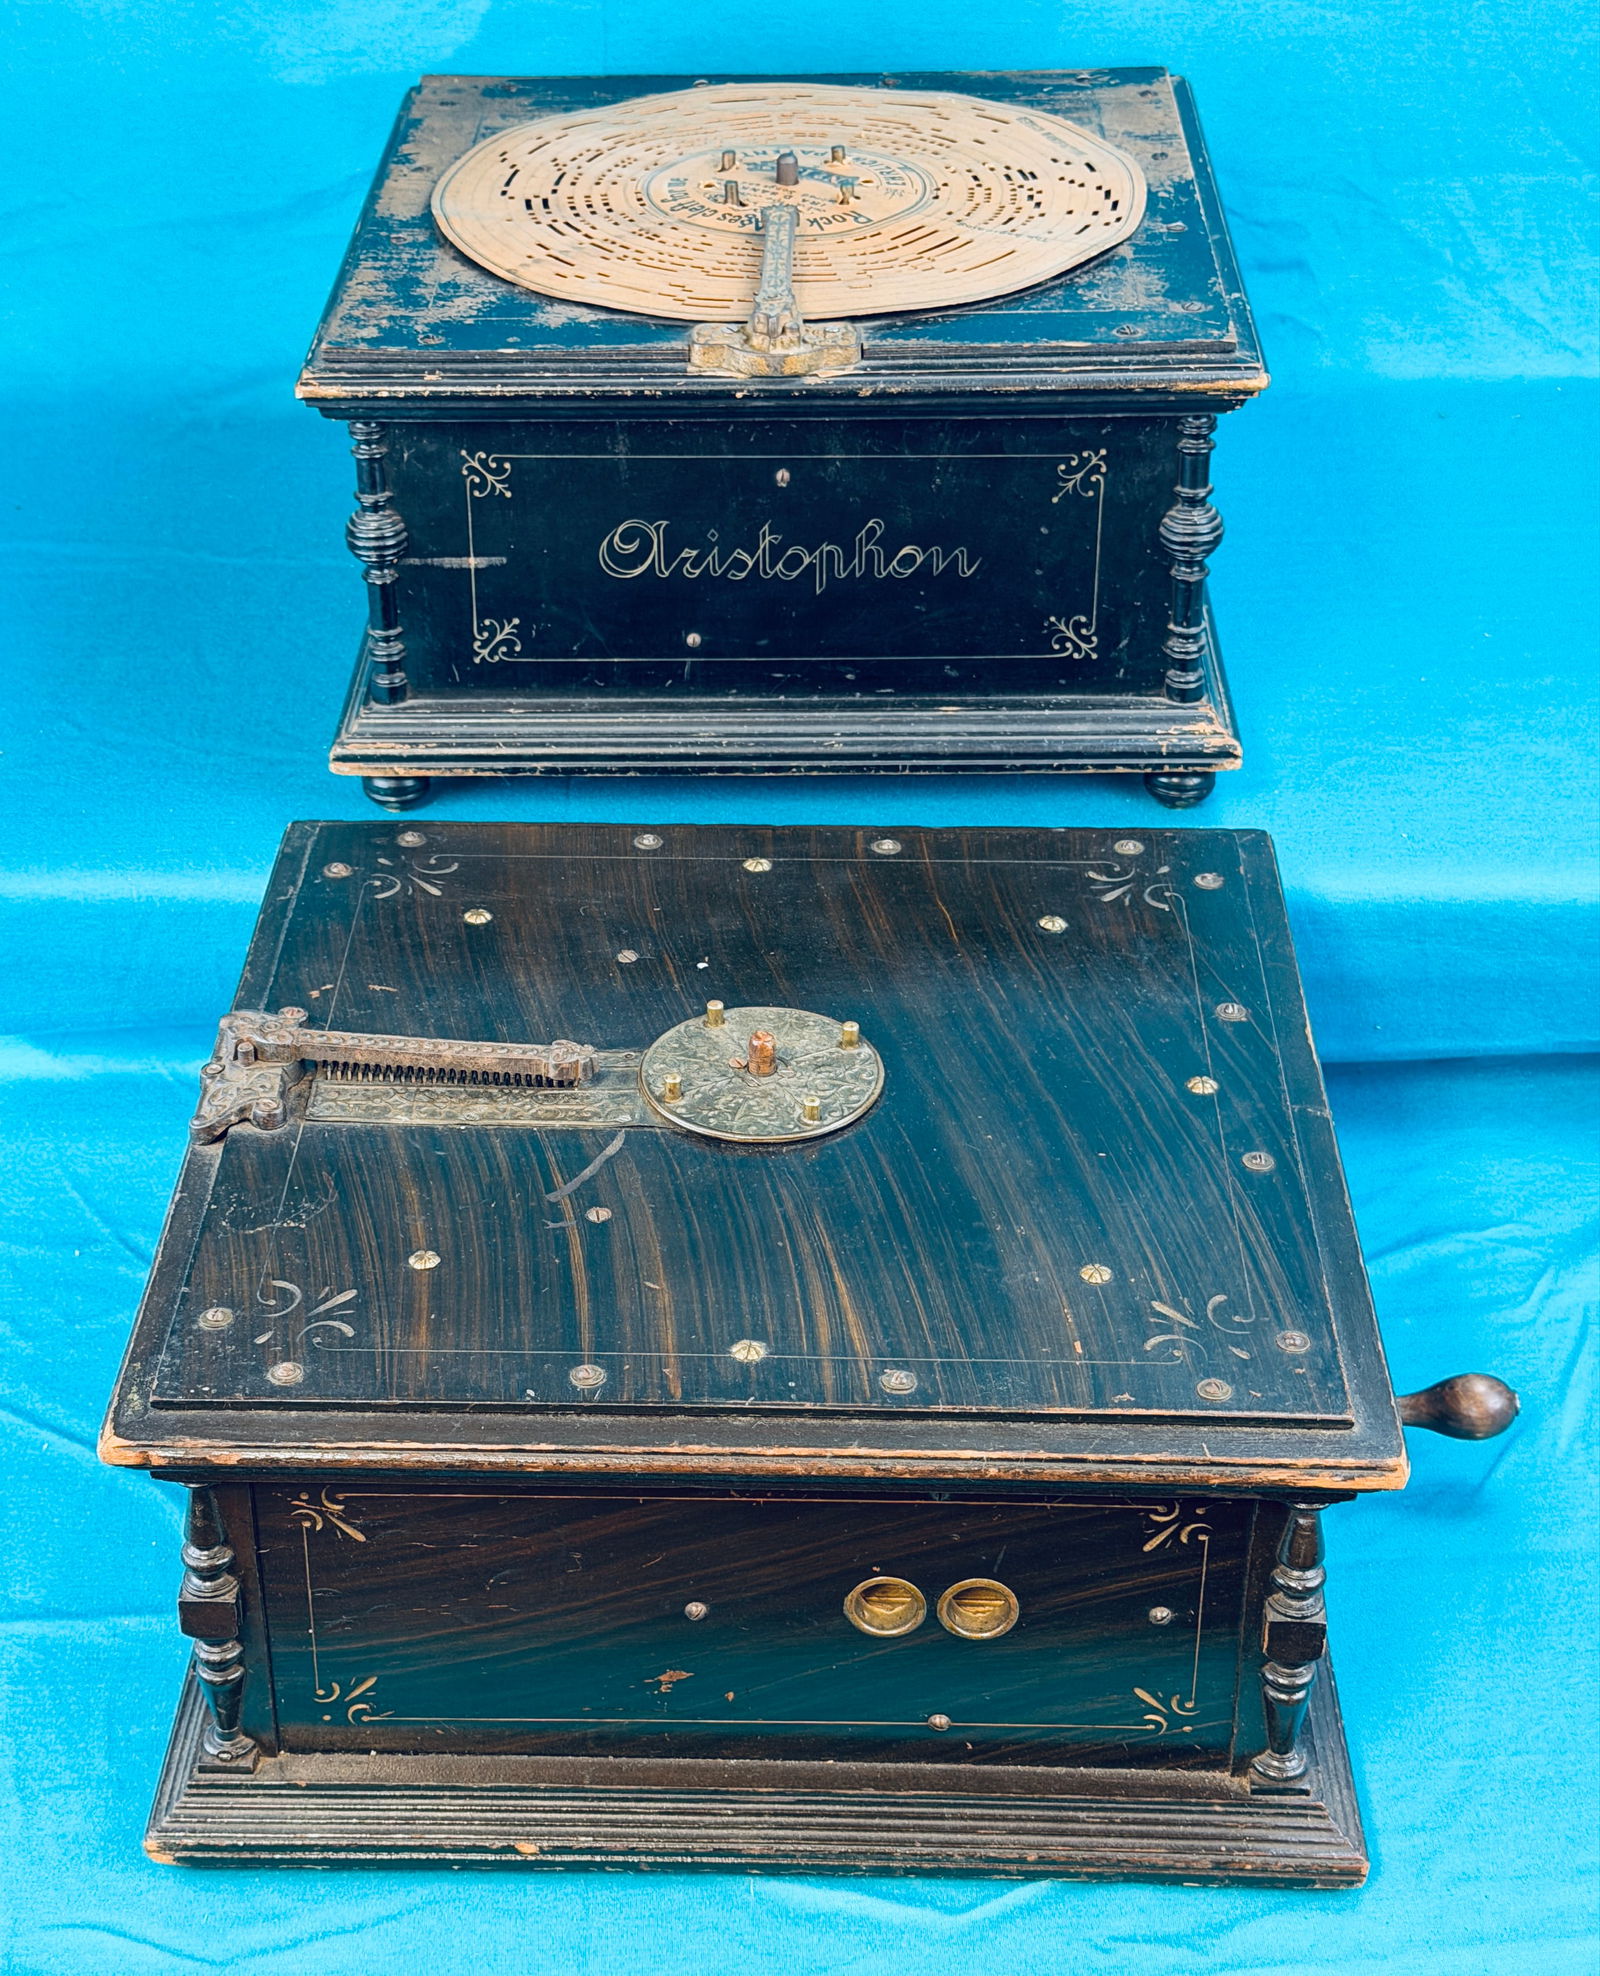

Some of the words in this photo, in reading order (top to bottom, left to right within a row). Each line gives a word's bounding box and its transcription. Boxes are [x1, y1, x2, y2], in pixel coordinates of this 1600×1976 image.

[660, 189, 691, 203] for
[669, 199, 719, 219] cleft
[806, 210, 874, 232] Rock
[599, 518, 982, 596] Aristophon
